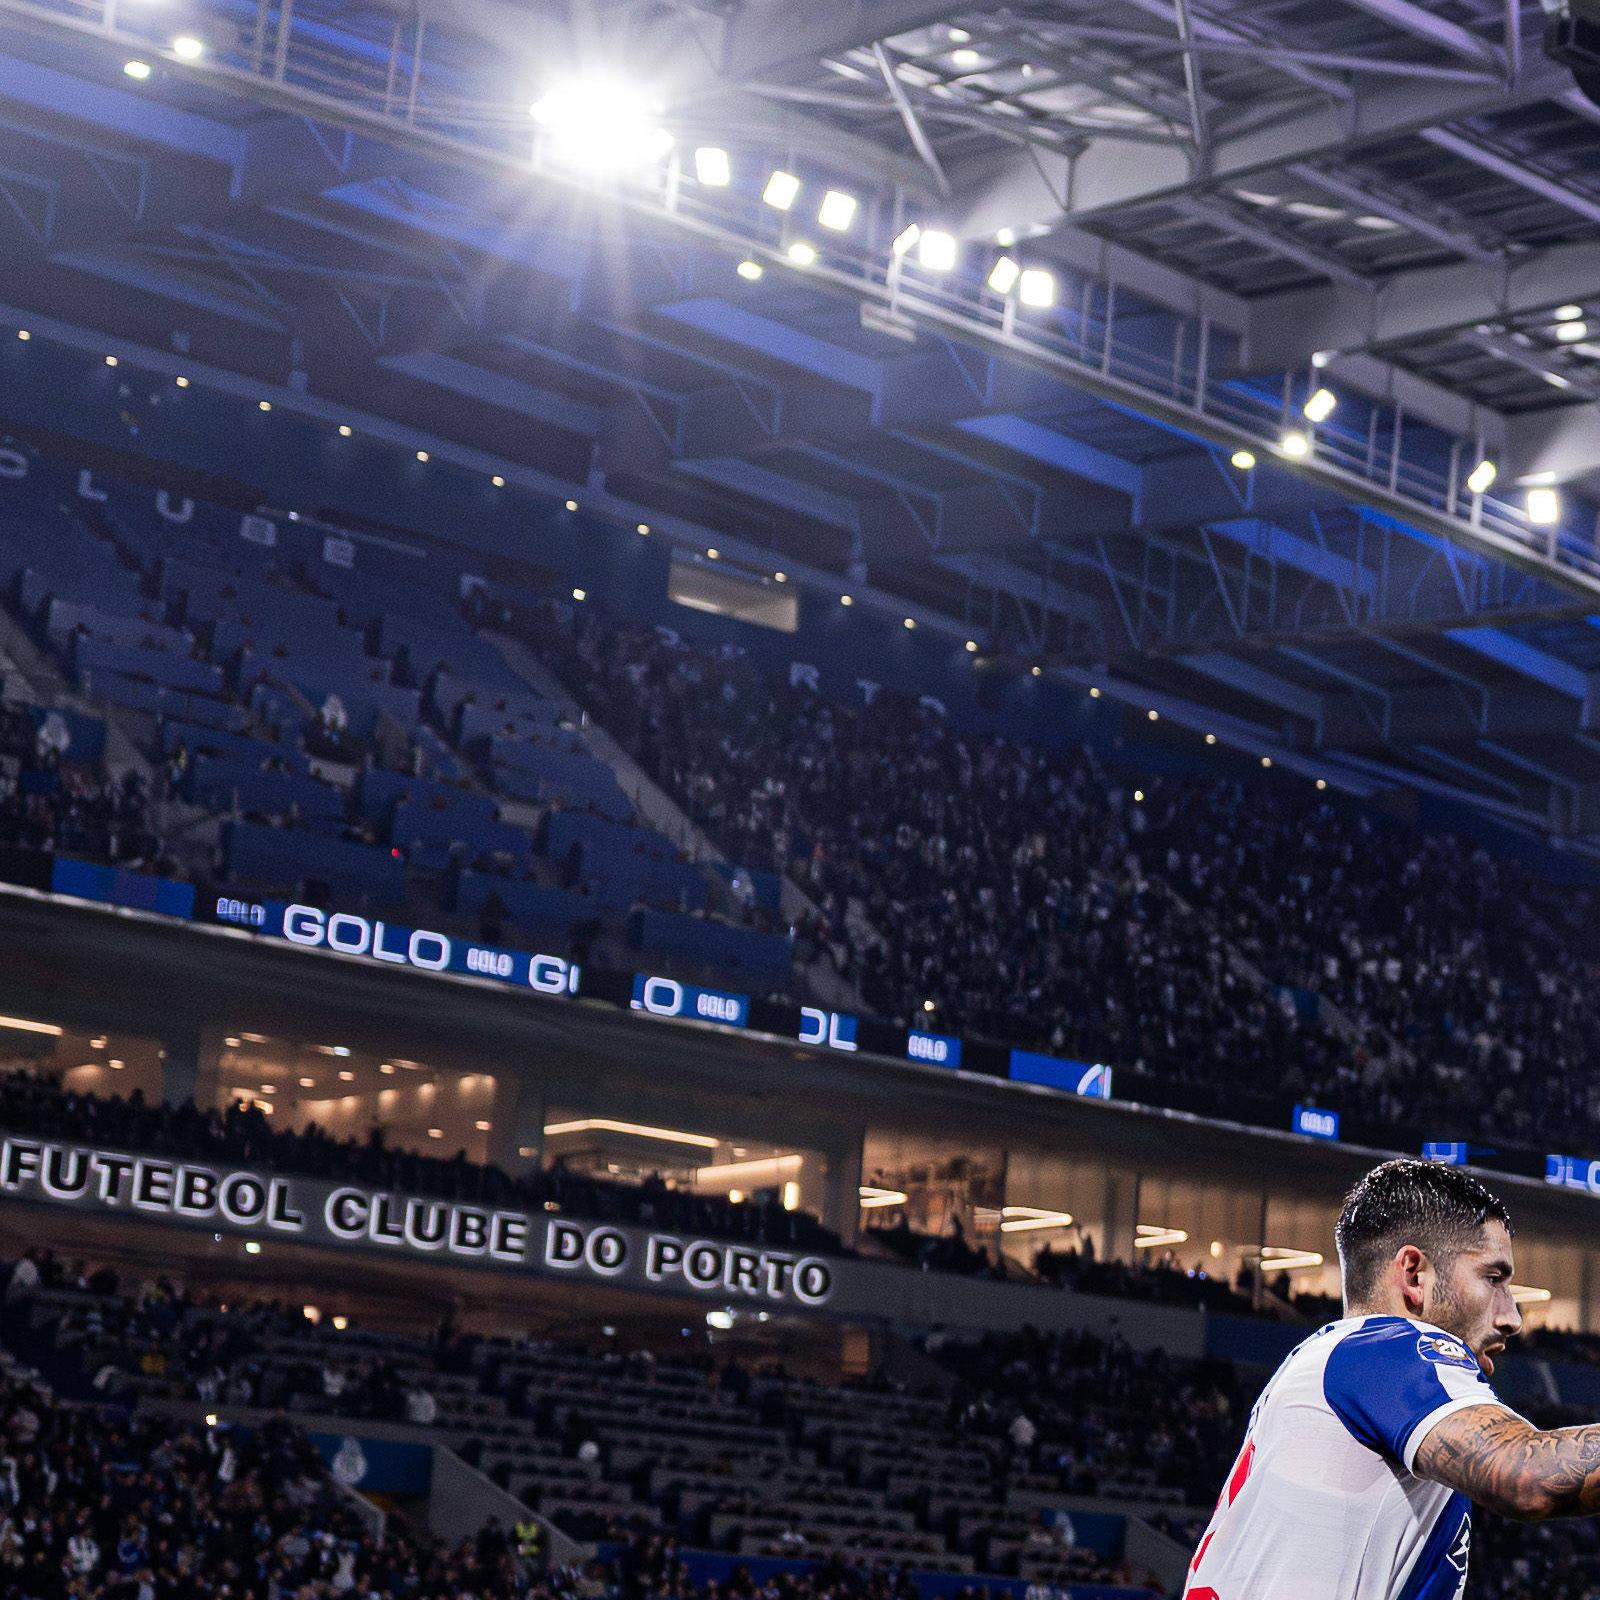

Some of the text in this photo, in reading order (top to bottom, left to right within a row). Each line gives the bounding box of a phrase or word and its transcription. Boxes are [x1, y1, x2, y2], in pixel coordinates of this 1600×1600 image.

[283, 903, 451, 970] GOLO
[1, 1137, 834, 1304] FUTEBOL CLUBE DO PORTO
